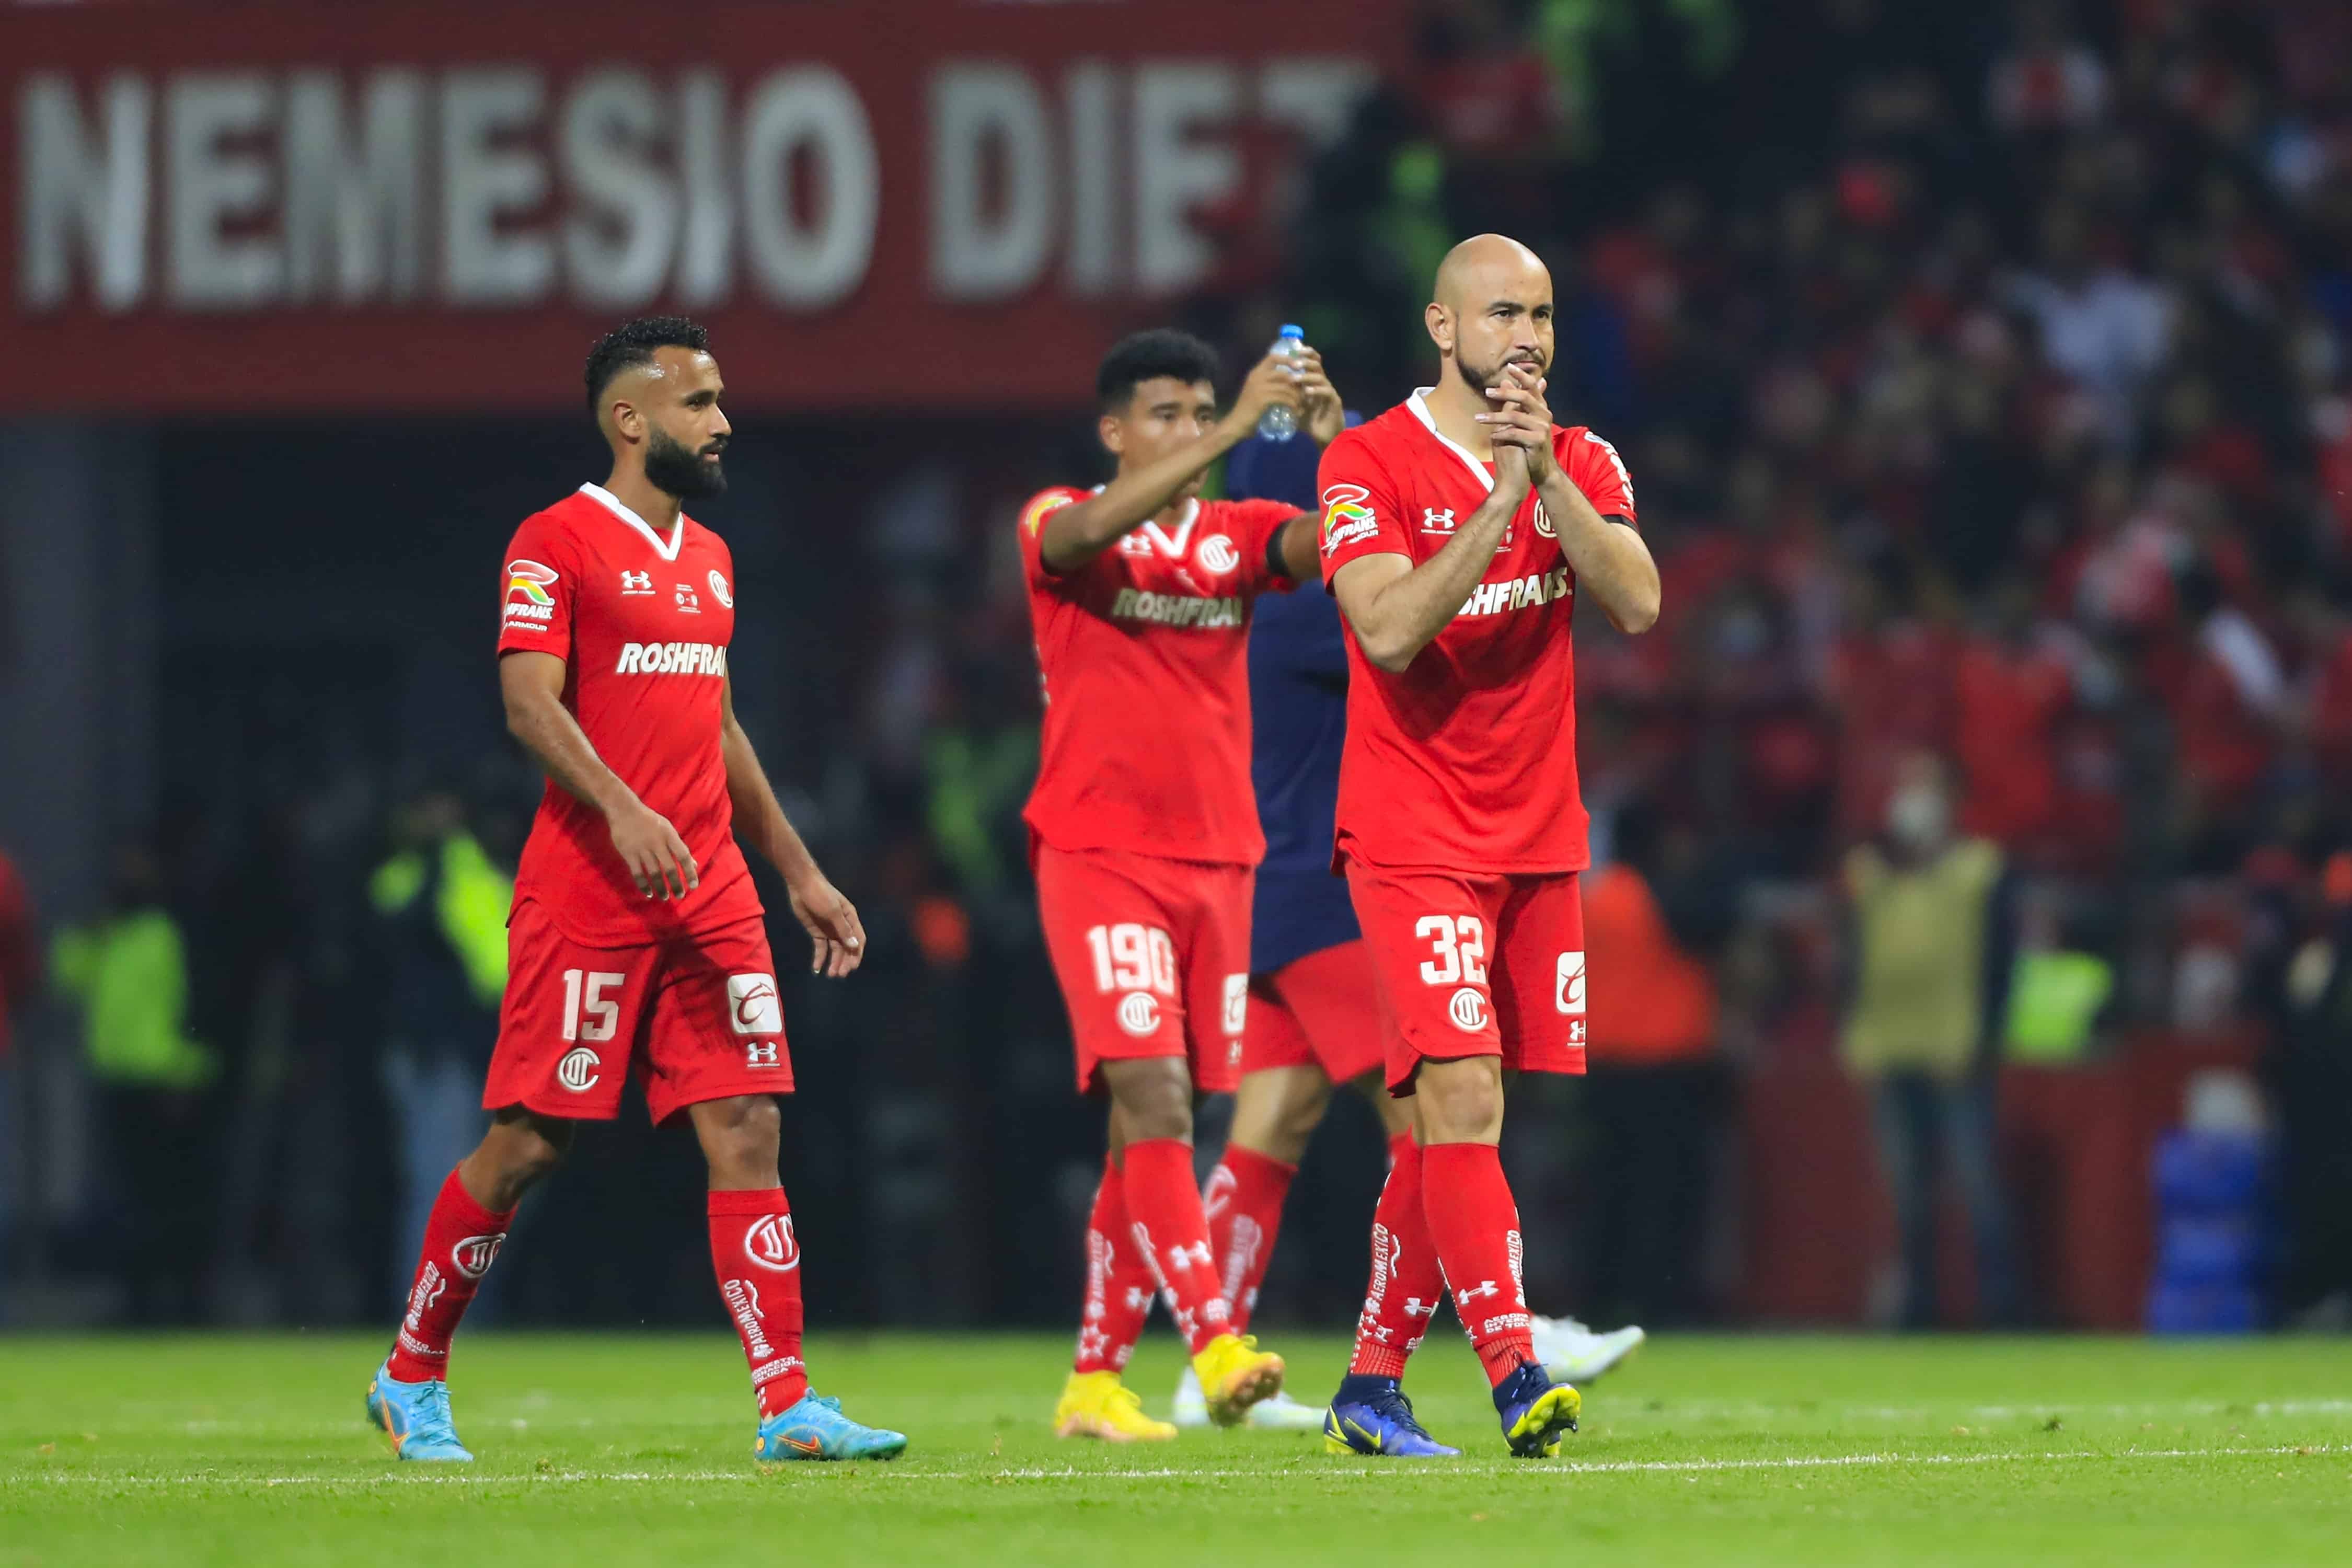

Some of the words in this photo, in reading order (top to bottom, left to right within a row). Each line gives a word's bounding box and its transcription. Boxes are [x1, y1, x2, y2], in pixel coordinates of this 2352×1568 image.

[22, 62, 880, 309] NEMESIO
[1086, 923, 1175, 996] 190
[1415, 915, 1487, 984] 32
[563, 969, 626, 1041] 15
[1370, 1222, 1389, 1301] AEROMEXICO
[724, 1279, 767, 1345] AEROMEXICO
